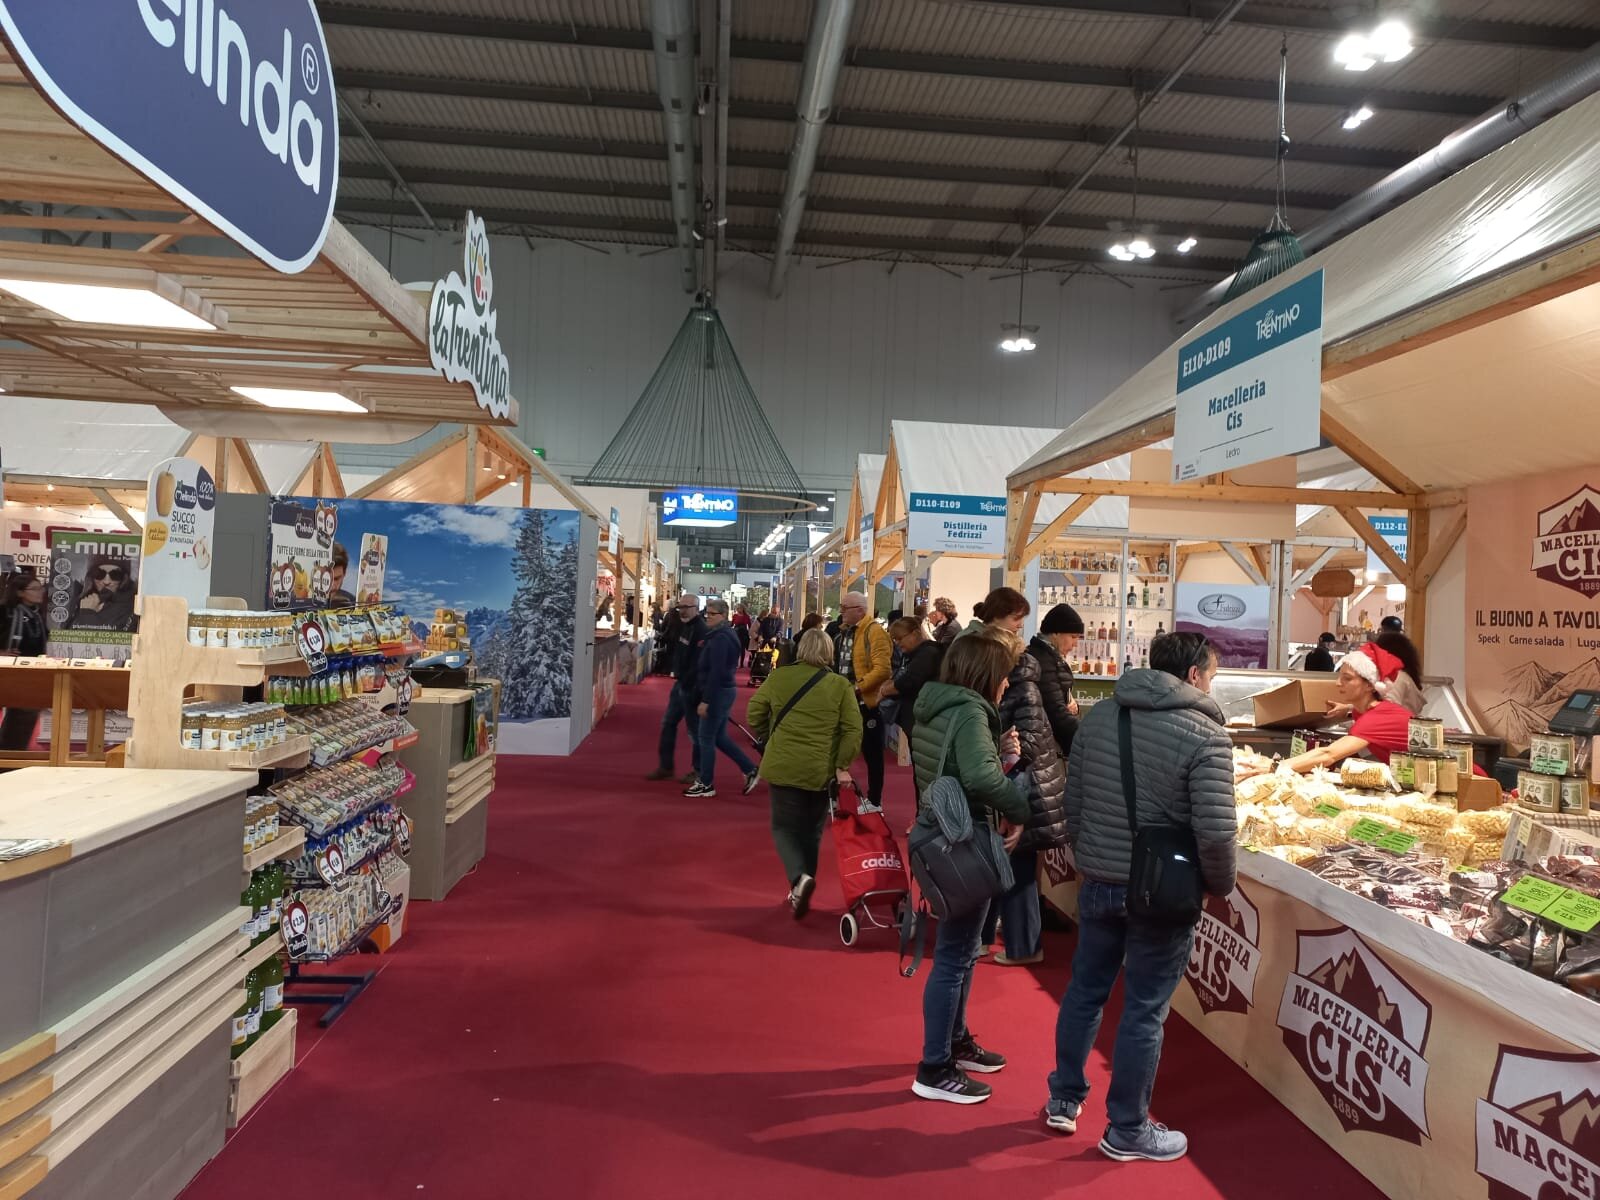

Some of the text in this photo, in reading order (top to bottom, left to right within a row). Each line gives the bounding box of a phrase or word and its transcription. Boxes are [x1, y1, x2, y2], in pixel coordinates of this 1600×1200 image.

[1182, 303, 1300, 377] E110-D109 TRENTINO
[1208, 379, 1266, 416] Macelleria
[1226, 411, 1242, 431] Cis
[915, 498, 961, 509] D110-E109
[172, 511, 196, 525] SUCCO
[943, 521, 988, 531] Distilleria
[178, 523, 195, 535] MELA
[947, 530, 982, 539] Fedrizzi
[1475, 610, 1486, 627] IL
[1489, 610, 1533, 627] BUONO
[1538, 611, 1549, 628] A
[1478, 633, 1500, 645] Speck
[1508, 634, 1533, 646] Carne
[1534, 635, 1565, 647] salada
[1293, 984, 1412, 1088] MACELLERIA
[1309, 1021, 1383, 1115] CIS
[1332, 1094, 1359, 1125] 1889
